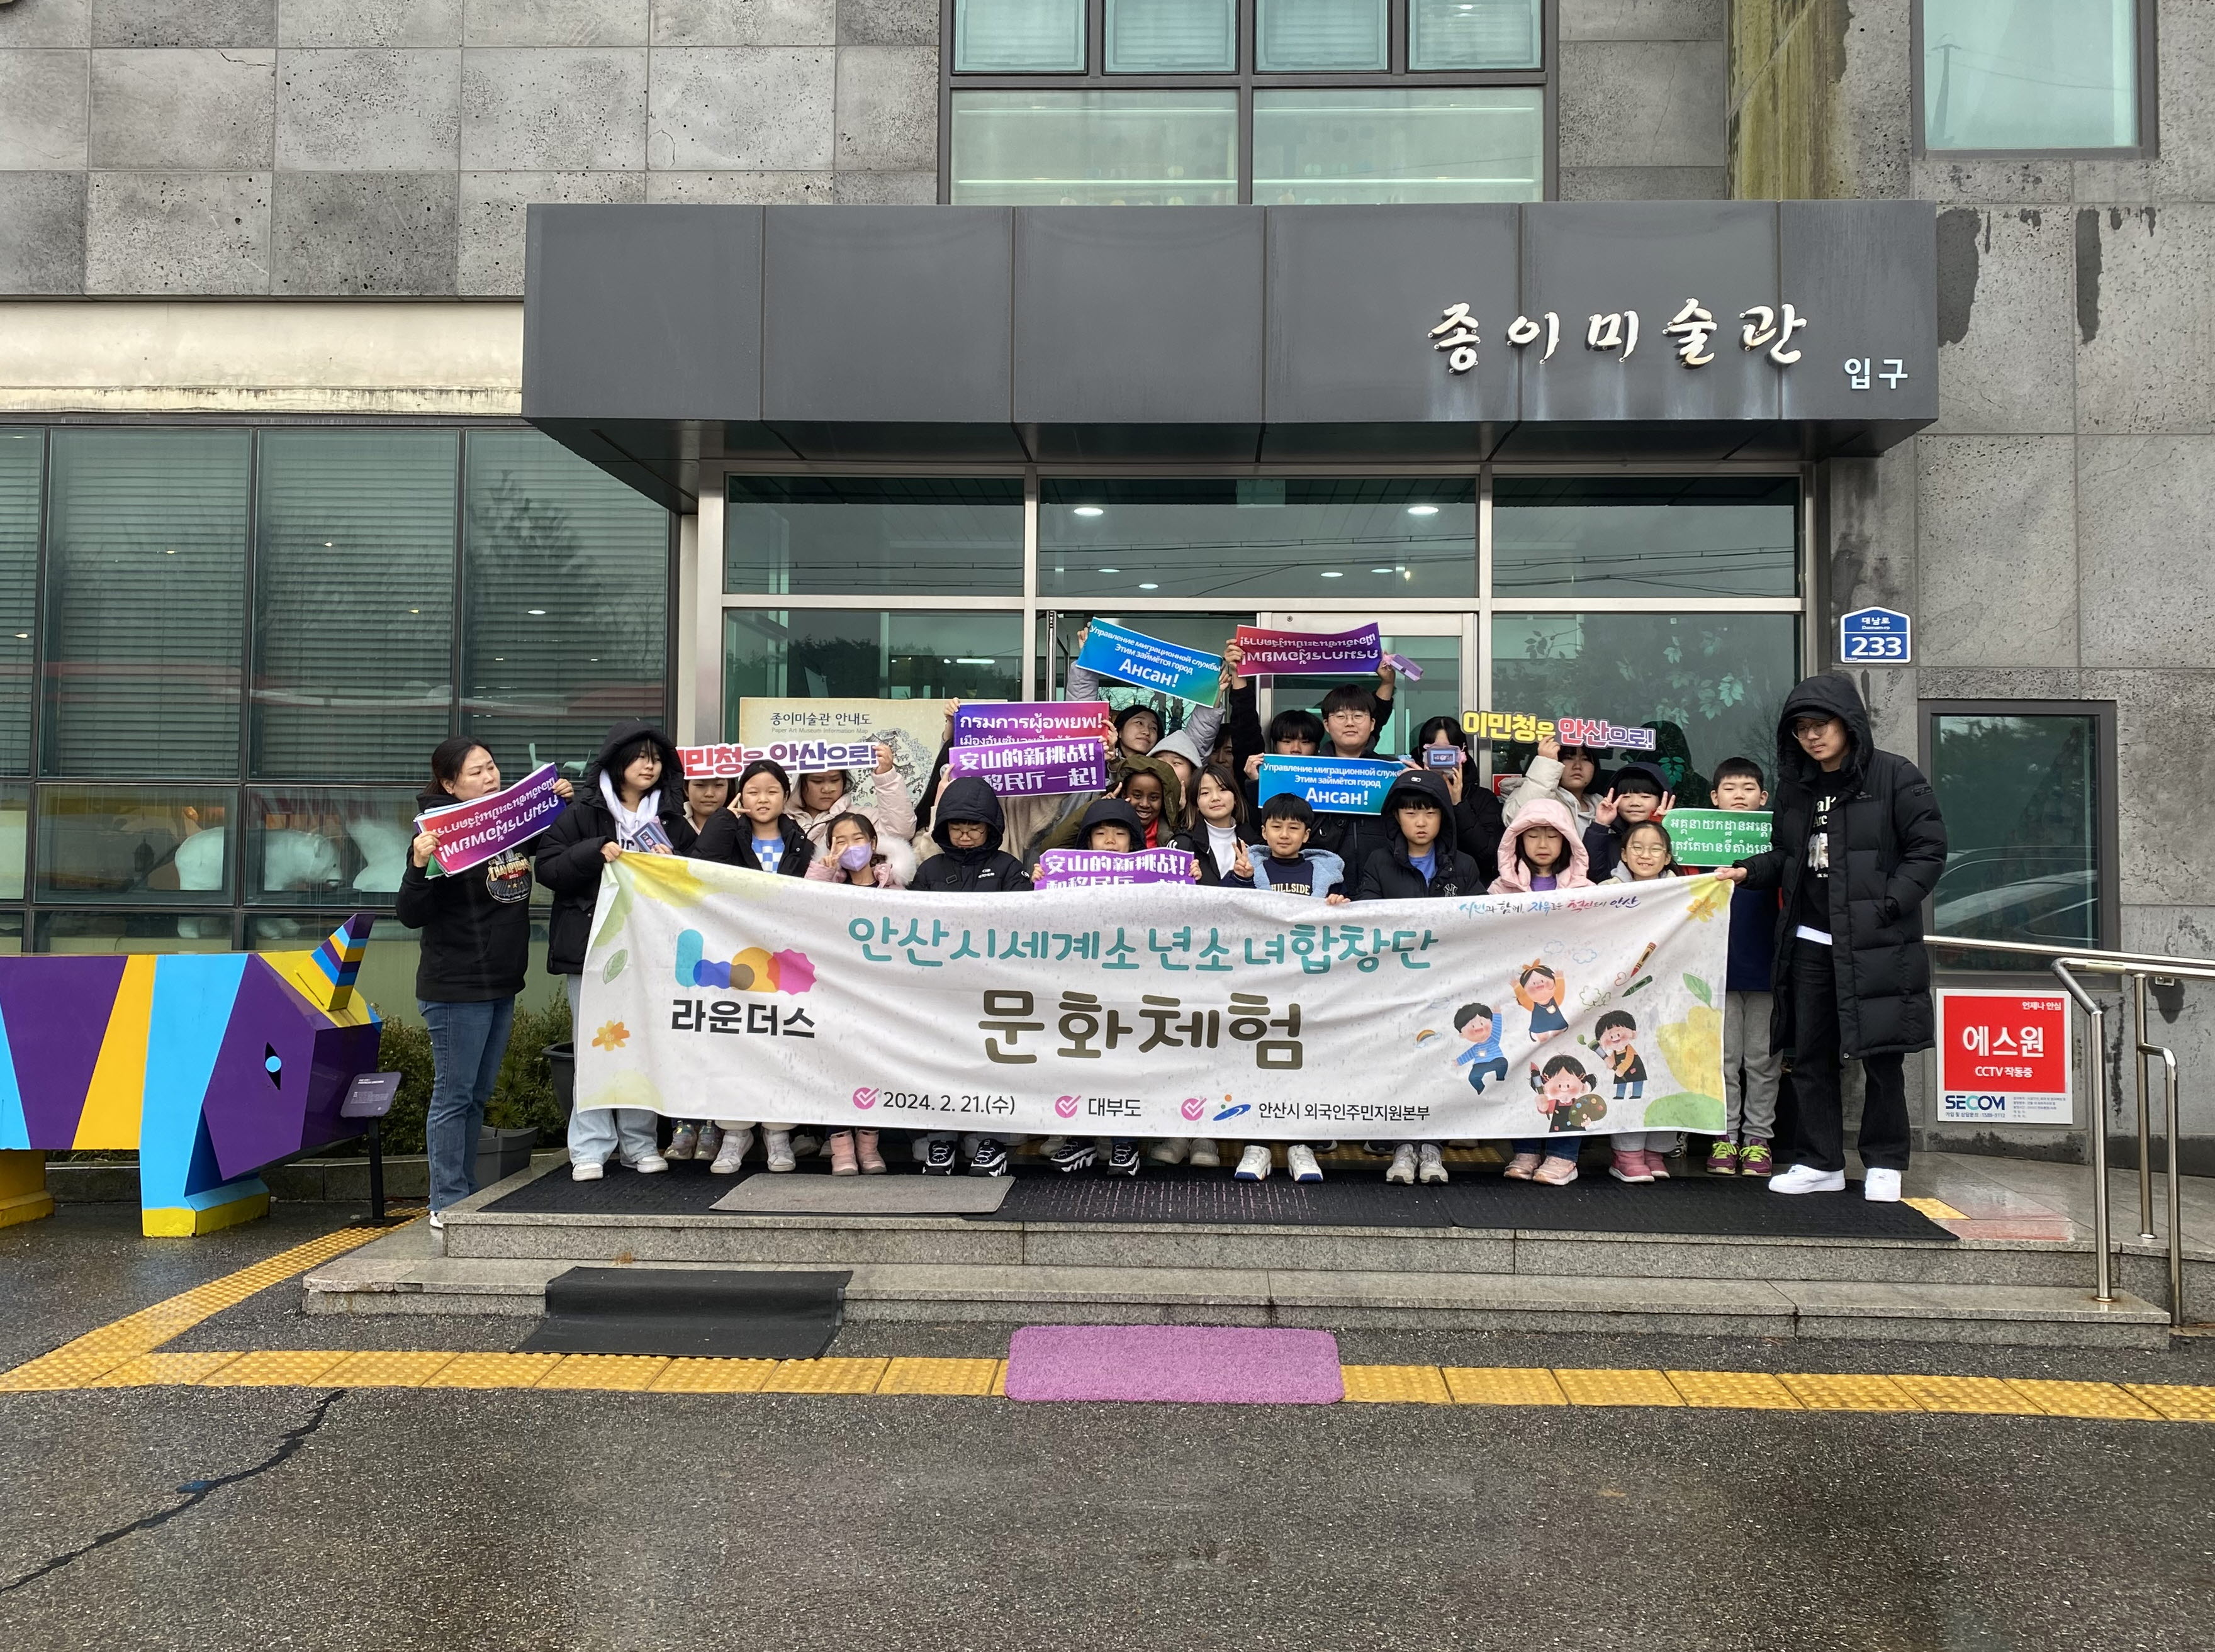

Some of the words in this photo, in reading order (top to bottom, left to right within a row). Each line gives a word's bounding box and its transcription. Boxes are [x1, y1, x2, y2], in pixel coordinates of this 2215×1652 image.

[1427, 297, 1808, 374] 종이미술관
[1844, 357, 1909, 391] 입구
[1089, 625, 1135, 646] Управление
[1135, 641, 1191, 662] миграционной
[1191, 658, 1221, 671] службы
[1242, 649, 1379, 666] กรมการผู้อพยพ!
[1851, 637, 1902, 656] 233
[1114, 644, 1135, 656] Этим
[1136, 650, 1171, 667] займётся
[1171, 661, 1194, 676] город
[1118, 658, 1180, 688] Ансан!
[770, 712, 831, 726] 종이미술관
[835, 712, 872, 726] 안내도
[960, 713, 1102, 733] กรมการผู้อพยพ!
[1462, 712, 1556, 742] 이민청은
[1559, 718, 1654, 750] 안산으로!
[770, 742, 877, 771] 안산으로!
[959, 743, 1095, 771] 安山的新挑战!
[979, 767, 1097, 791] 移民厅一起!
[1263, 762, 1313, 774] Управление
[1313, 766, 1376, 777] миграционной
[1376, 769, 1401, 779] служ
[1294, 775, 1317, 784] Этим
[1318, 775, 1357, 786] займётся
[1357, 779, 1381, 788] город
[1305, 787, 1369, 805] Ансан!
[439, 795, 559, 863] กรมการผู้อพยพ!
[1045, 853, 1186, 876] 安山的新挑战!
[1270, 883, 1311, 895] HILLSIDE
[1610, 896, 1642, 909] 안산
[2022, 1001, 2045, 1010] 언제나
[2046, 1002, 2061, 1011] 안심
[671, 999, 816, 1039] 라운더스
[979, 990, 1303, 1070] 문화체험
[1963, 1026, 2044, 1058] 에스원
[1975, 1066, 2004, 1077] CCTV
[2004, 1067, 2033, 1078] 작동중
[883, 1091, 935, 1111] 2024.
[939, 1095, 955, 1112] 2.
[960, 1095, 1016, 1115] 21.(수)
[1088, 1098, 1141, 1117] 대부도
[1259, 1102, 1299, 1119] 안산시
[1304, 1103, 1430, 1121] 외국인주민지원본부
[1946, 1095, 2005, 1110] SECOM
